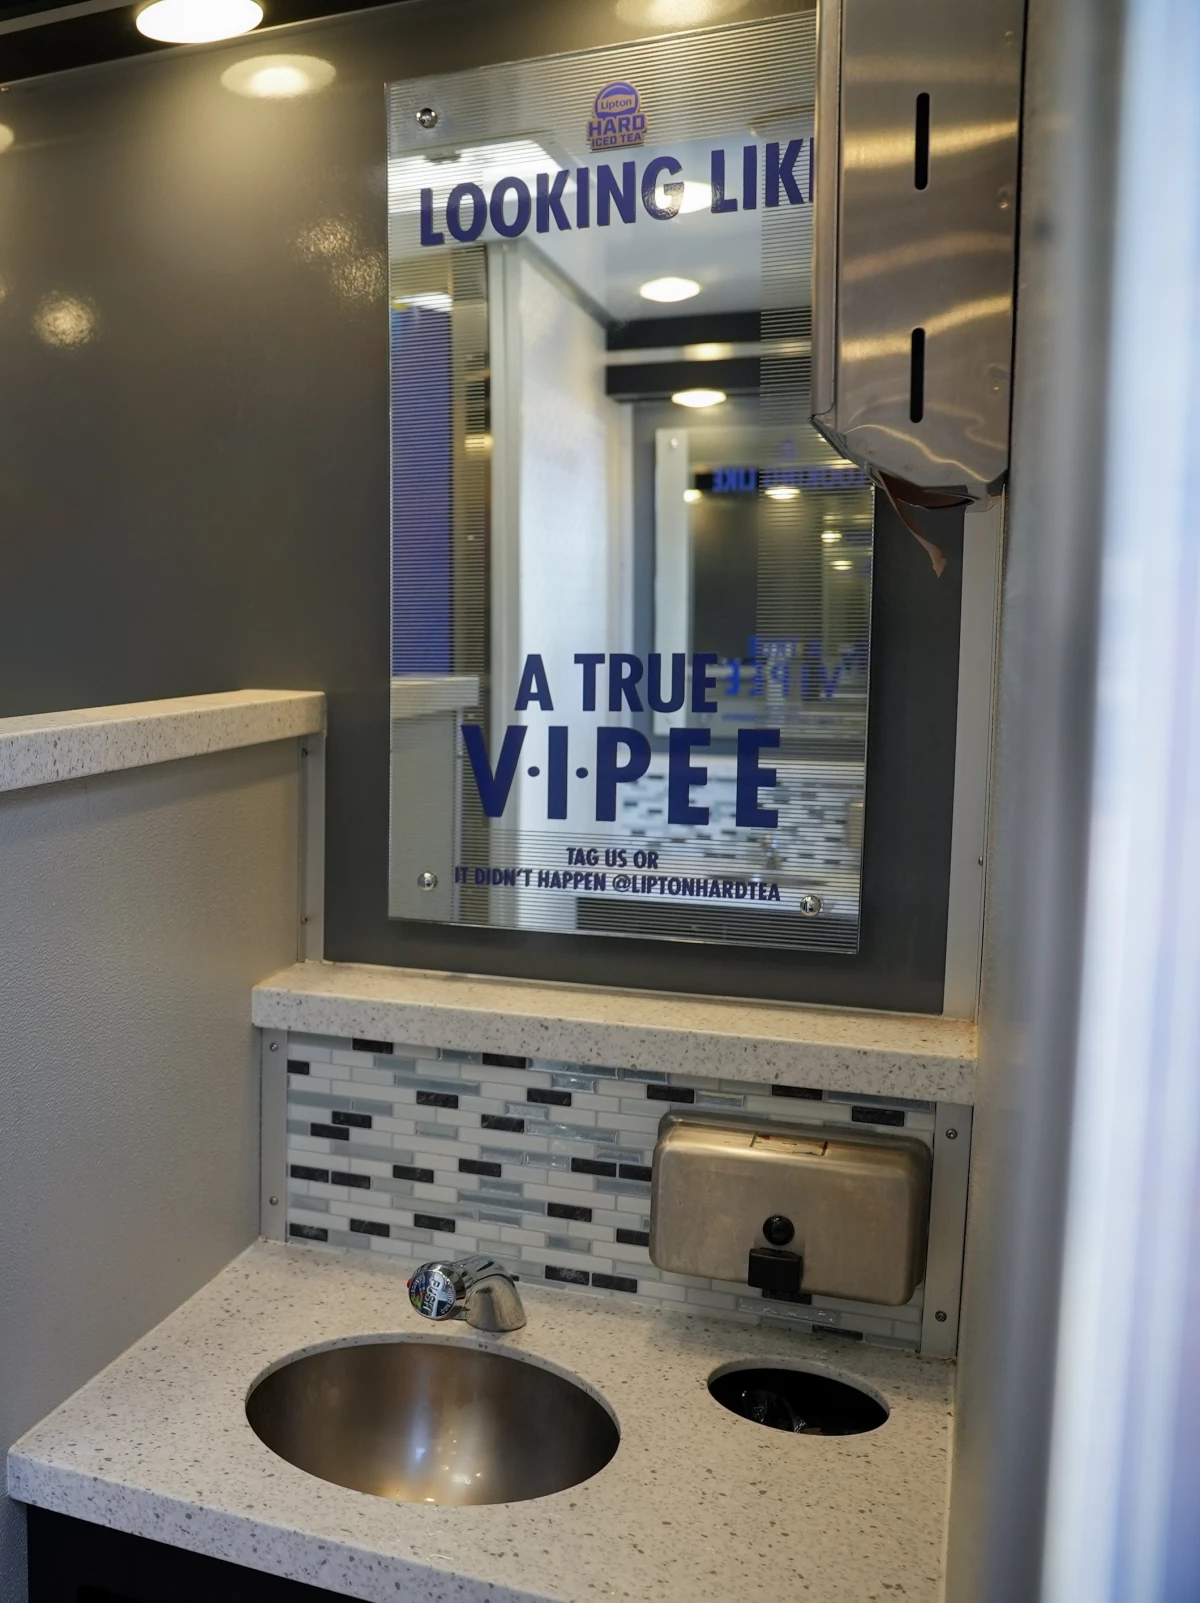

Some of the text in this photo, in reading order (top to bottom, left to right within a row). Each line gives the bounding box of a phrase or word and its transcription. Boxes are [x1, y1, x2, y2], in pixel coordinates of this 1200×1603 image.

[601, 99, 632, 110] Lipton
[588, 114, 645, 138] HARD
[592, 132, 642, 147] ICED TEA
[420, 155, 685, 246] LOOKING
[514, 653, 718, 713] A TRUE
[566, 847, 659, 869] TAG US OR
[454, 866, 781, 902] IT DIDN'T HAPPEN @LIPTONHARDTEA
[422, 1280, 440, 1311] PUSH
